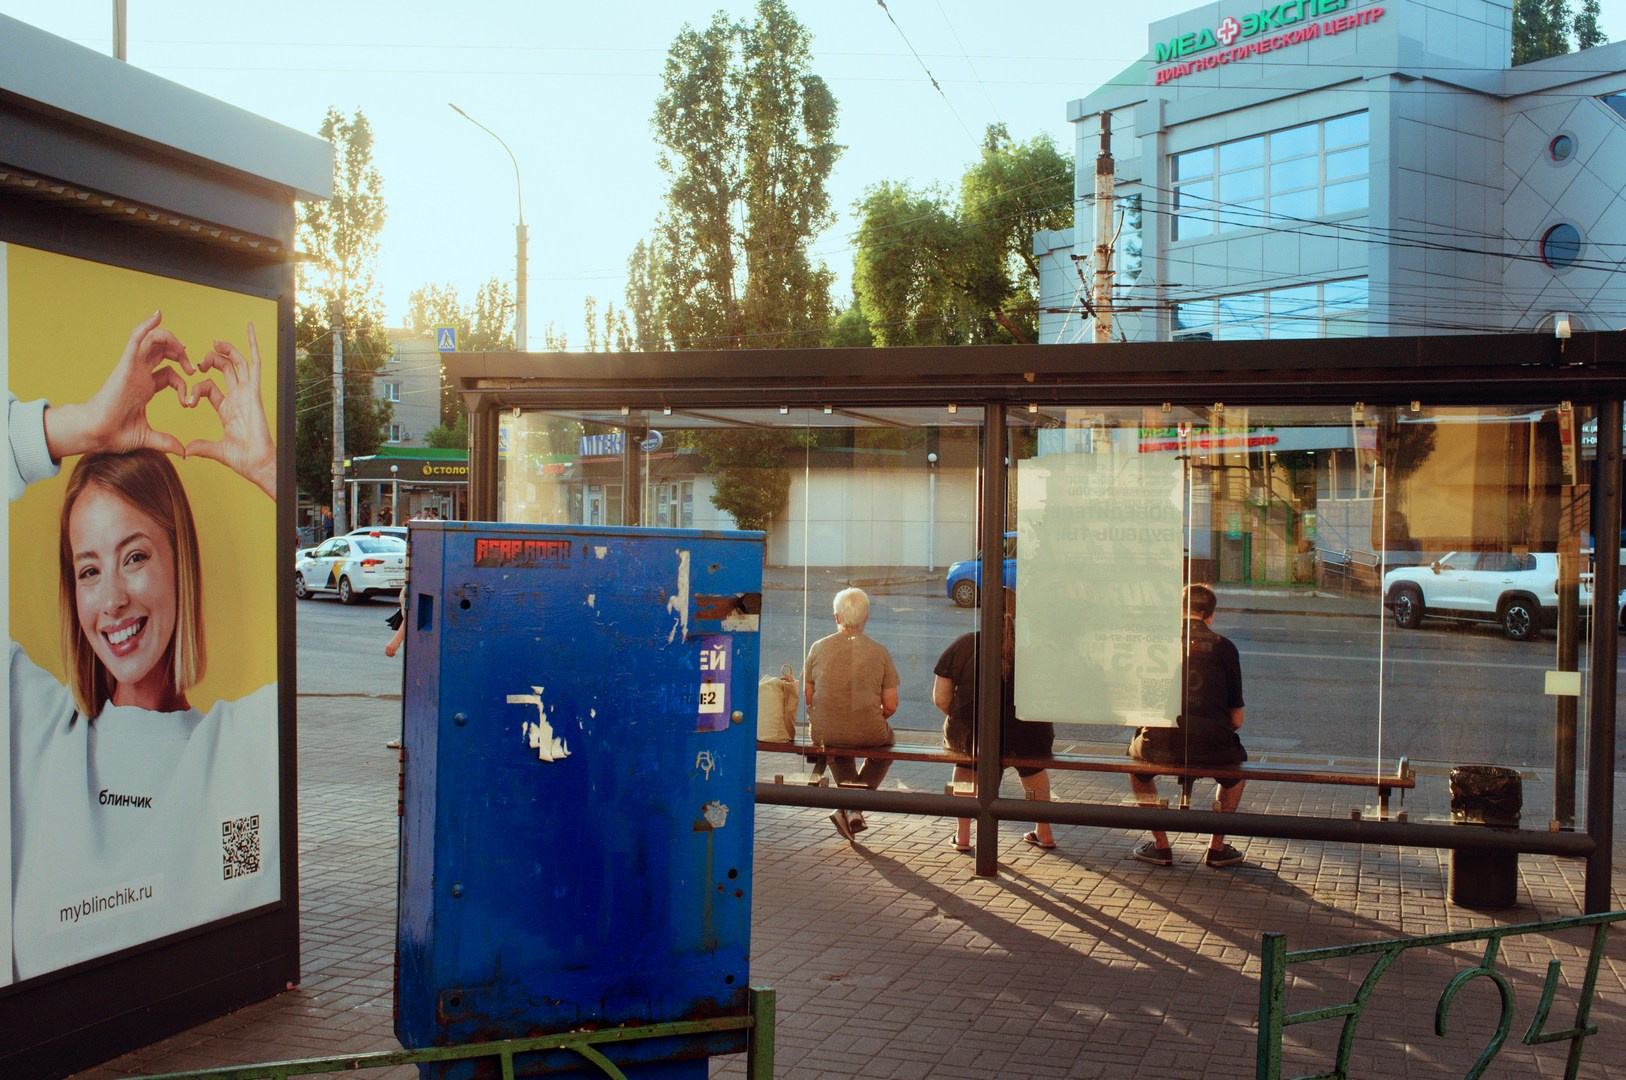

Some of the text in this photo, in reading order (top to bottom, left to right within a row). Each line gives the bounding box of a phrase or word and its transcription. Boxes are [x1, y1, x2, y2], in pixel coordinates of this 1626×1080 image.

[1155, 28, 1217, 64] МЕД
[1155, 7, 1385, 86] ДИАГНОСТИЧЕСКИЙ ЦЕНТР
[99, 789, 152, 808] блинчик
[60, 885, 153, 923] myblinchik.ru
